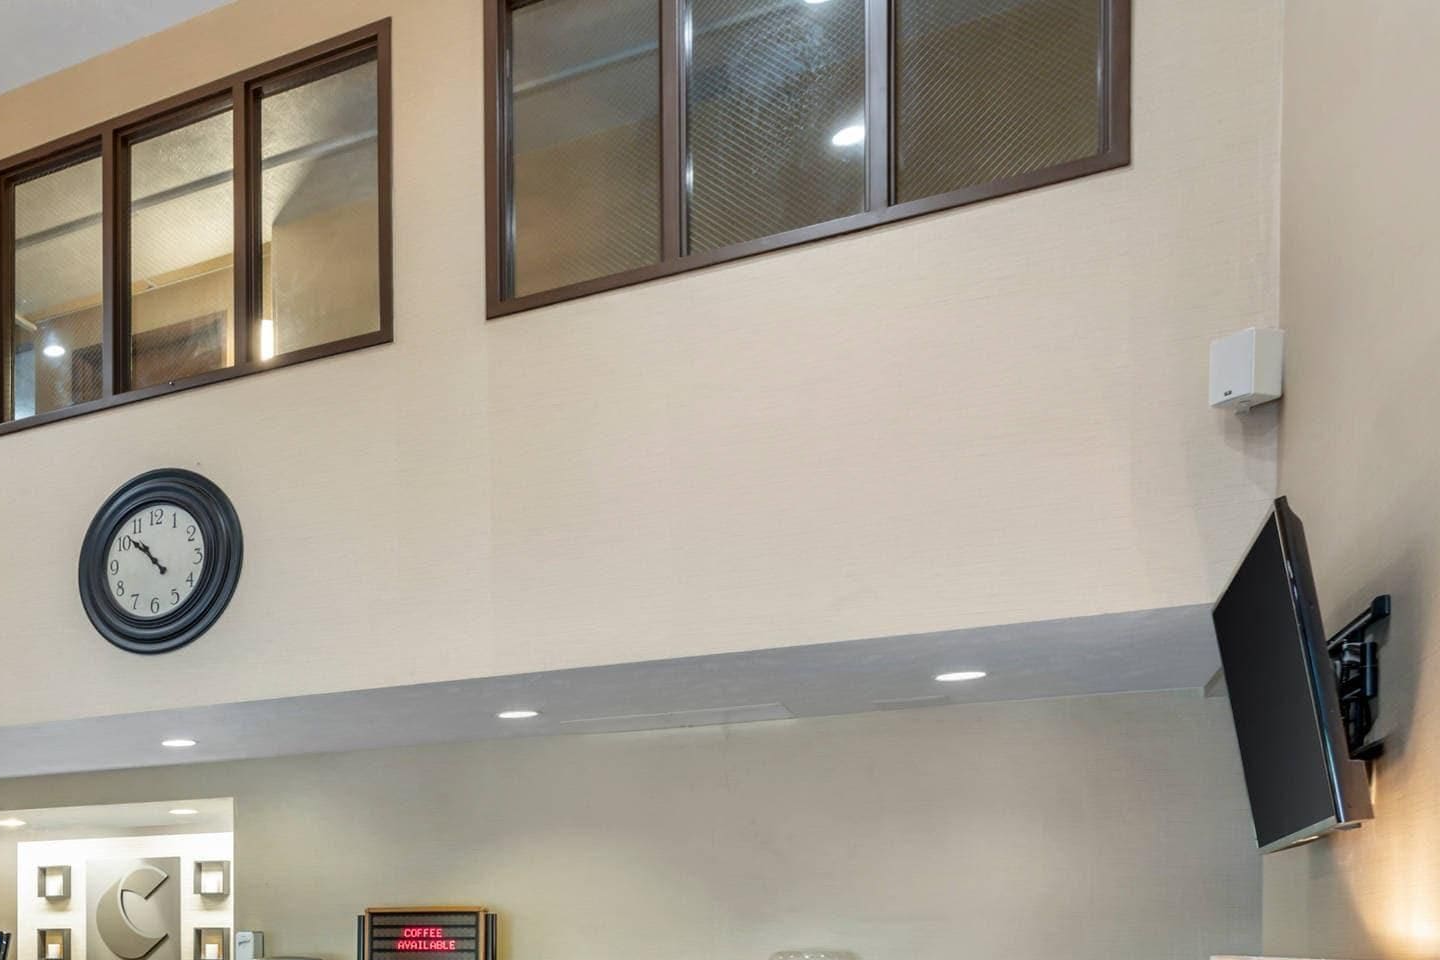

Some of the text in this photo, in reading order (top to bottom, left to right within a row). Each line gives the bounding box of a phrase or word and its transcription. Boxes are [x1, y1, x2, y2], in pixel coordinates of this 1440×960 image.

[150, 508, 164, 526] 12
[171, 512, 178, 528] 1
[132, 518, 142, 534] 11
[186, 525, 197, 542] 2
[117, 535, 131, 552] 10
[193, 548, 203, 565] 3
[110, 560, 119, 576] 9
[185, 572, 194, 588] 4
[116, 580, 125, 597] 8
[130, 594, 139, 610] 7
[170, 588, 180, 606] 5
[150, 597, 160, 614] 6
[404, 928, 443, 938] COFFEE
[398, 940, 456, 950] AVAILABLE
